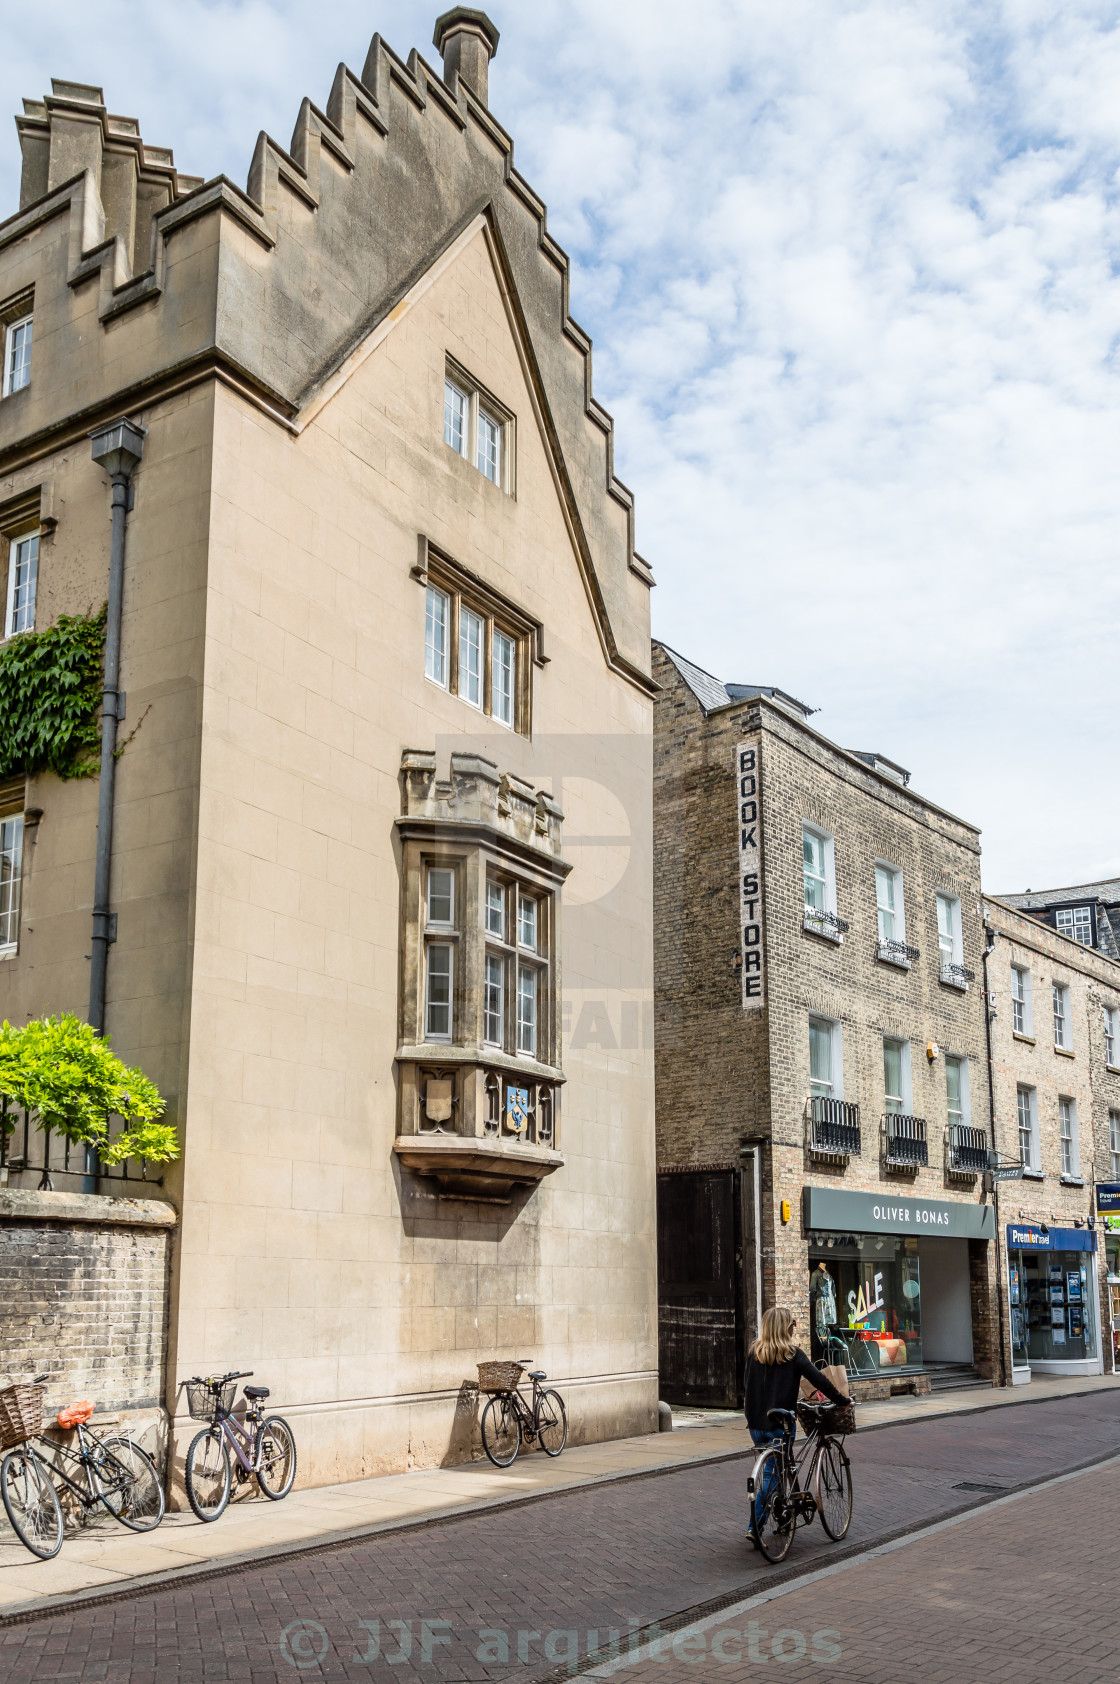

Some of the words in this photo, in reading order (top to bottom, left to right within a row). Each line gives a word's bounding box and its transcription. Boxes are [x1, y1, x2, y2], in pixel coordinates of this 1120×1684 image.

[740, 749, 758, 850] BOOK
[743, 873, 761, 998] STORE
[873, 1205, 910, 1222] OLIVER
[915, 1209, 949, 1225] BONAS
[1012, 1229, 1039, 1244] Premier
[847, 1271, 885, 1325] SALE
